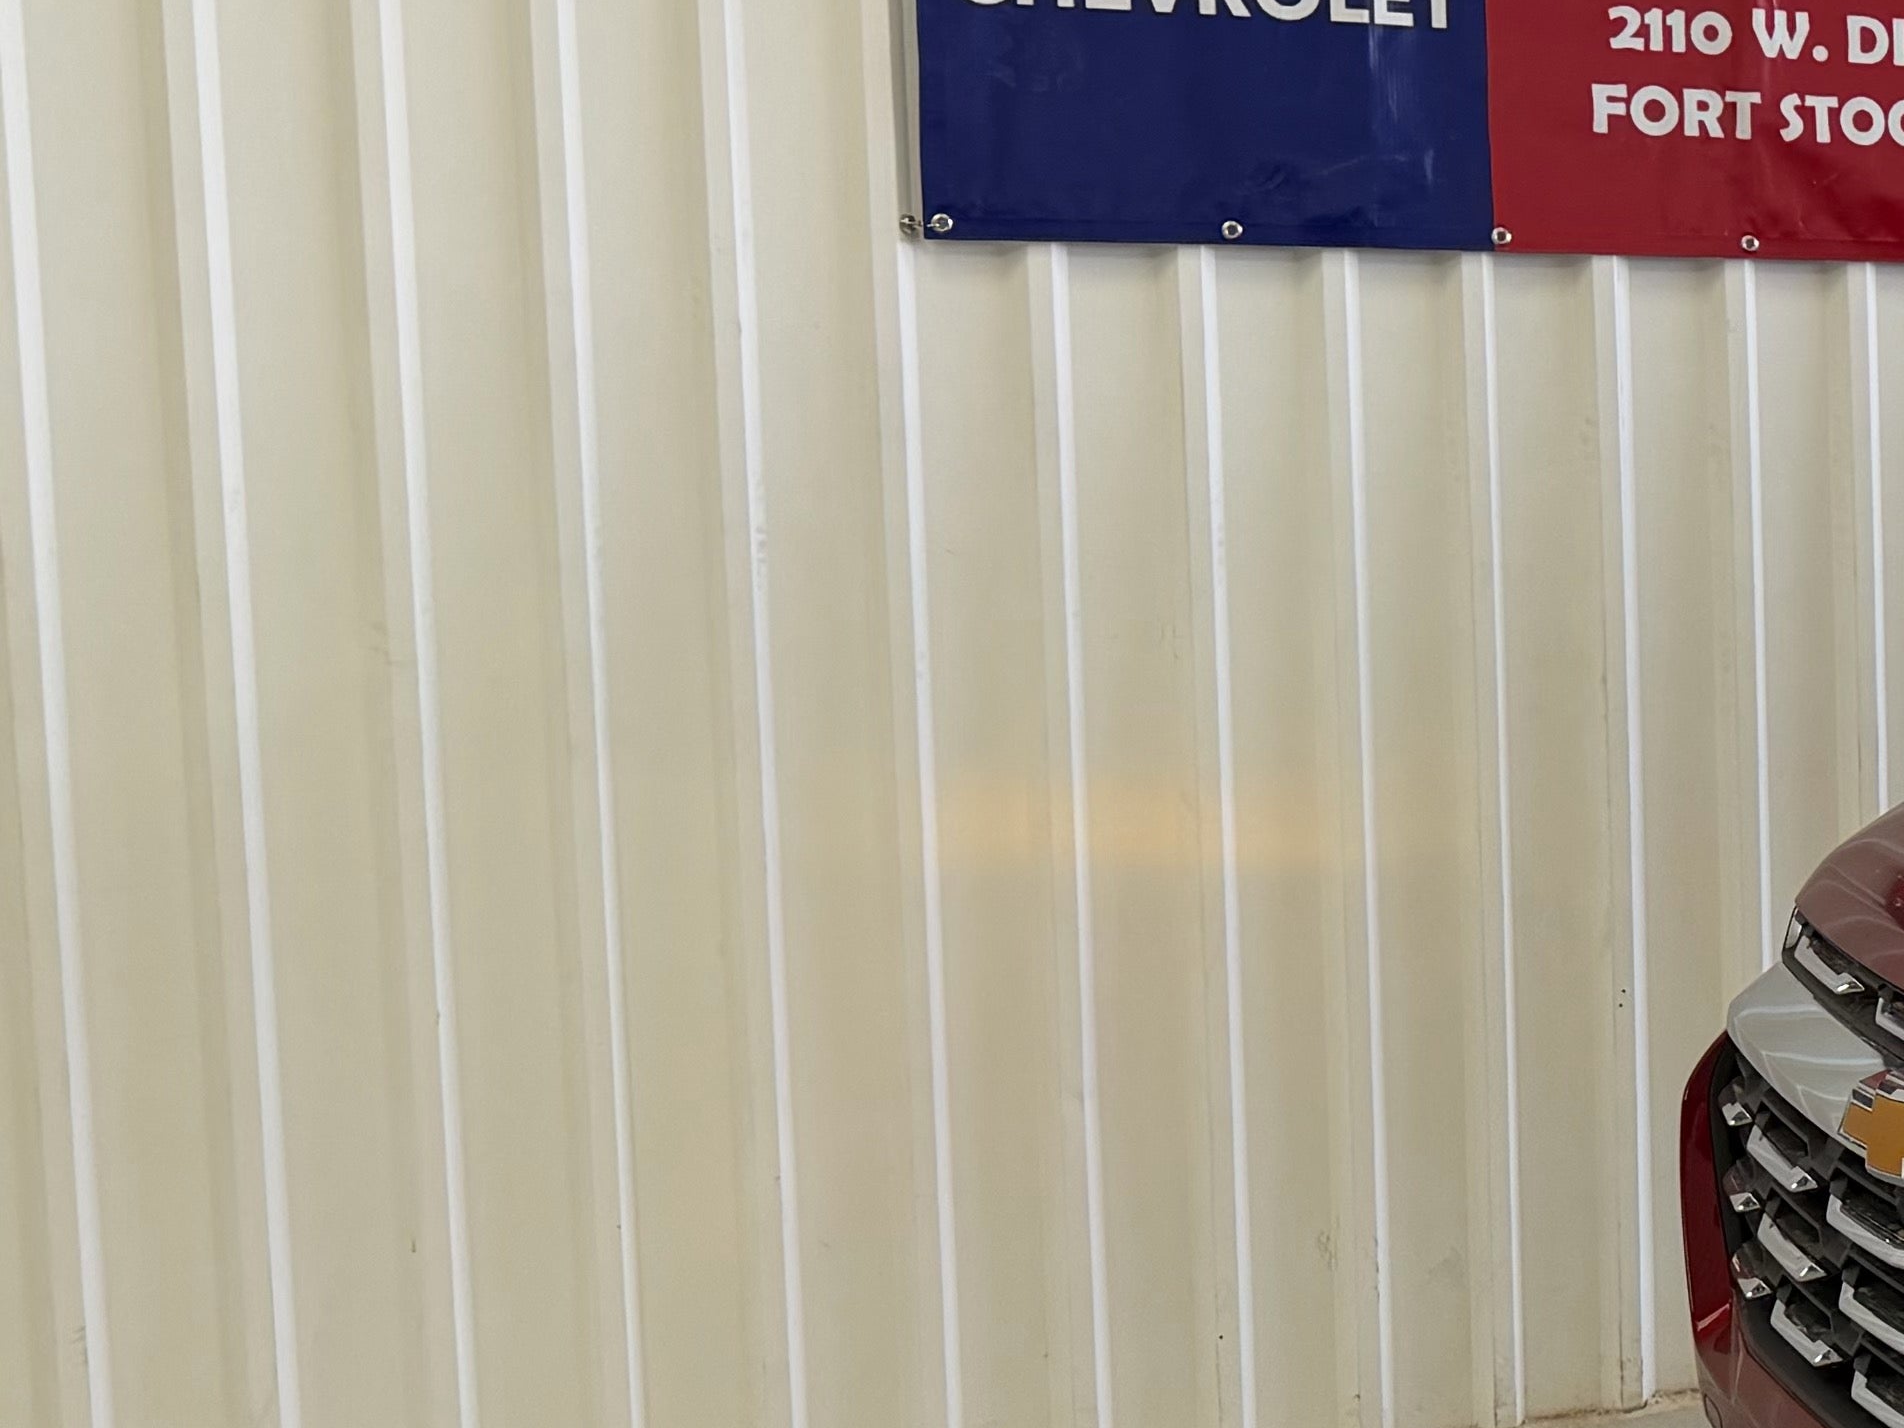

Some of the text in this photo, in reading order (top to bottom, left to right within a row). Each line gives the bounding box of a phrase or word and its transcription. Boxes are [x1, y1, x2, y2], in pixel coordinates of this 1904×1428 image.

[1607, 5, 1733, 56] 2110
[1751, 7, 1829, 63] W.
[1590, 84, 1762, 141] FORT
